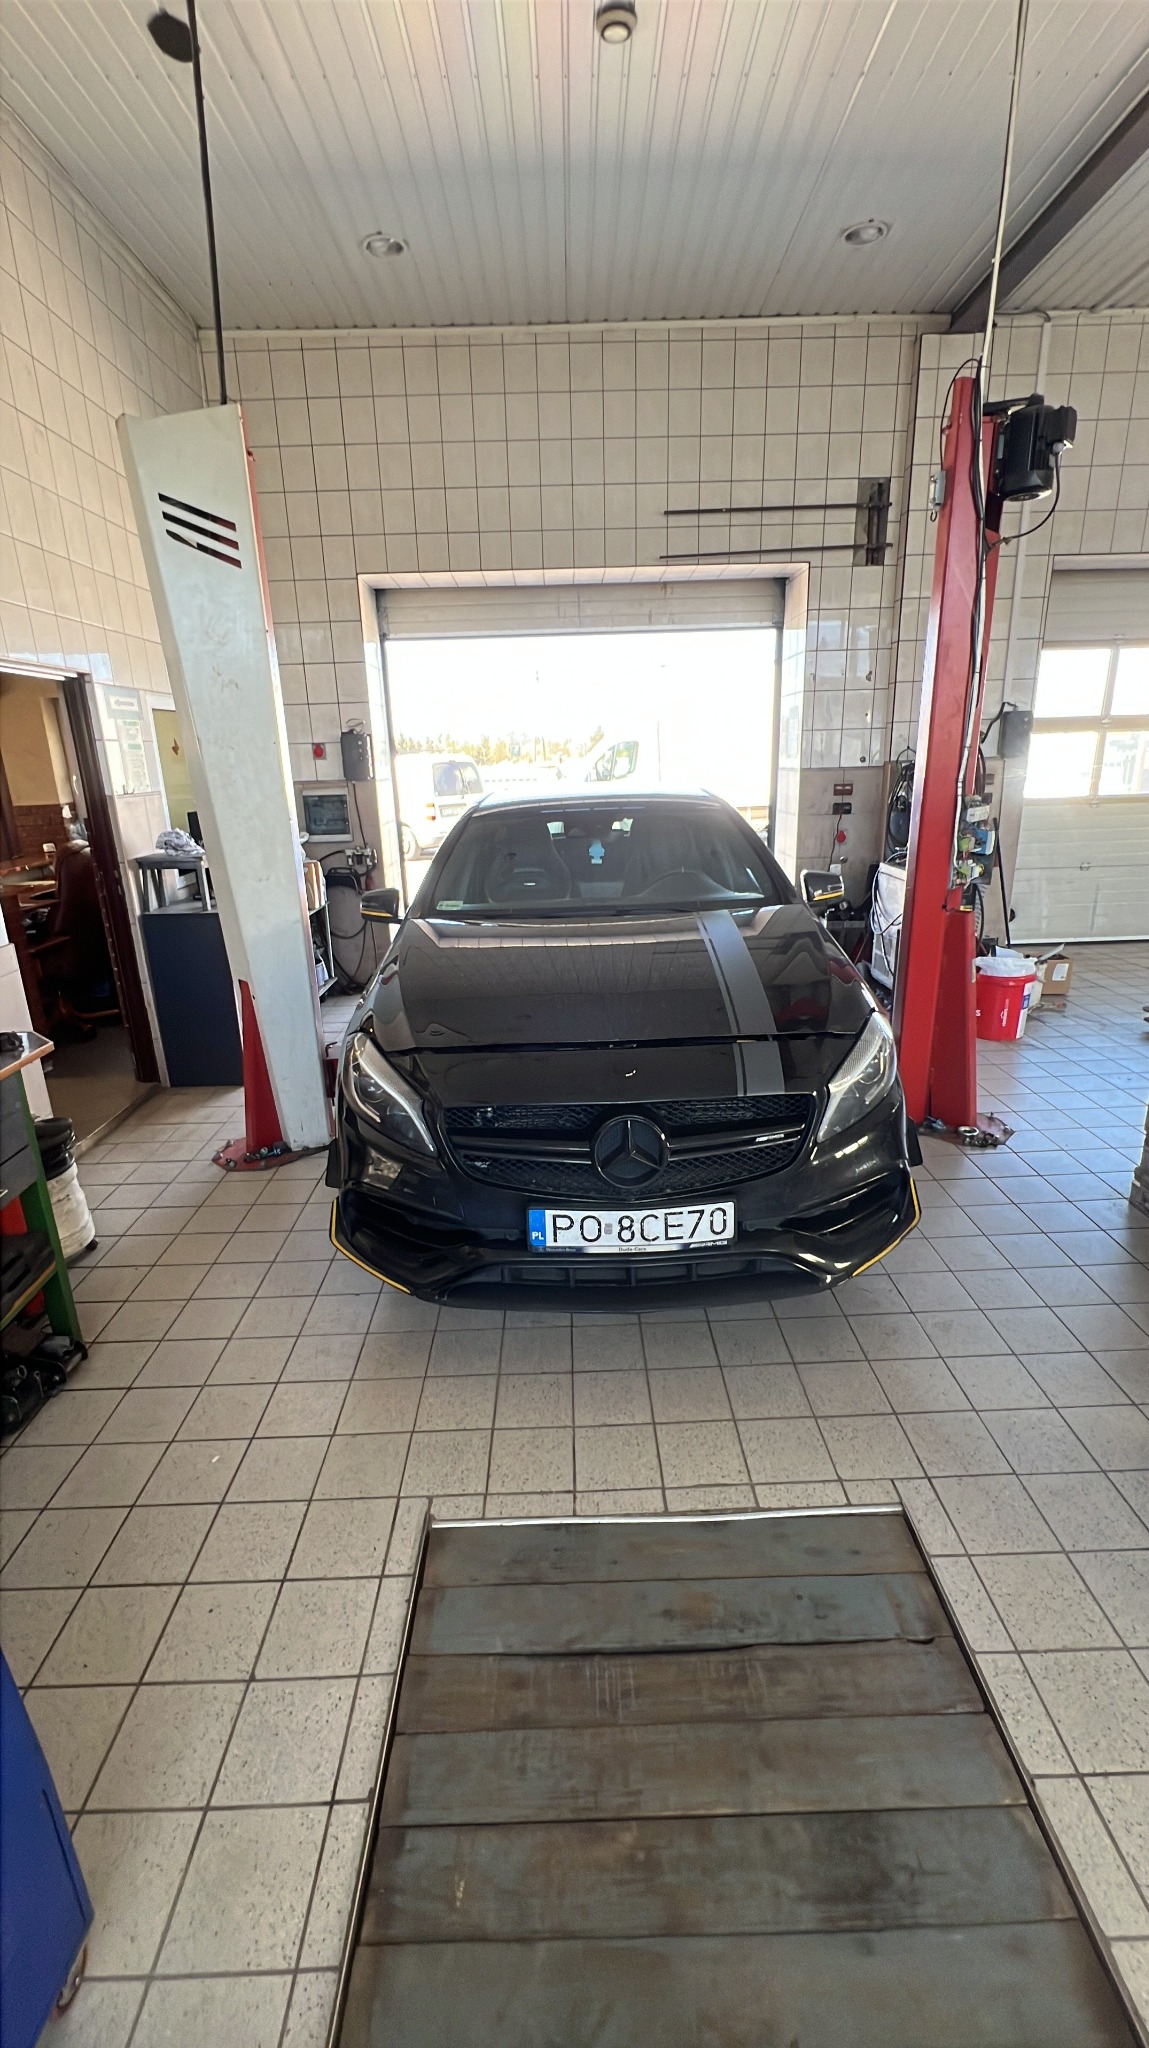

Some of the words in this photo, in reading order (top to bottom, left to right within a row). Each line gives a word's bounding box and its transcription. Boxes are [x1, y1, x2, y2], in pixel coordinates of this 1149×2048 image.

[531, 1231, 544, 1240] PL
[552, 1214, 602, 1243] PO
[617, 1207, 727, 1243] 8CE70
